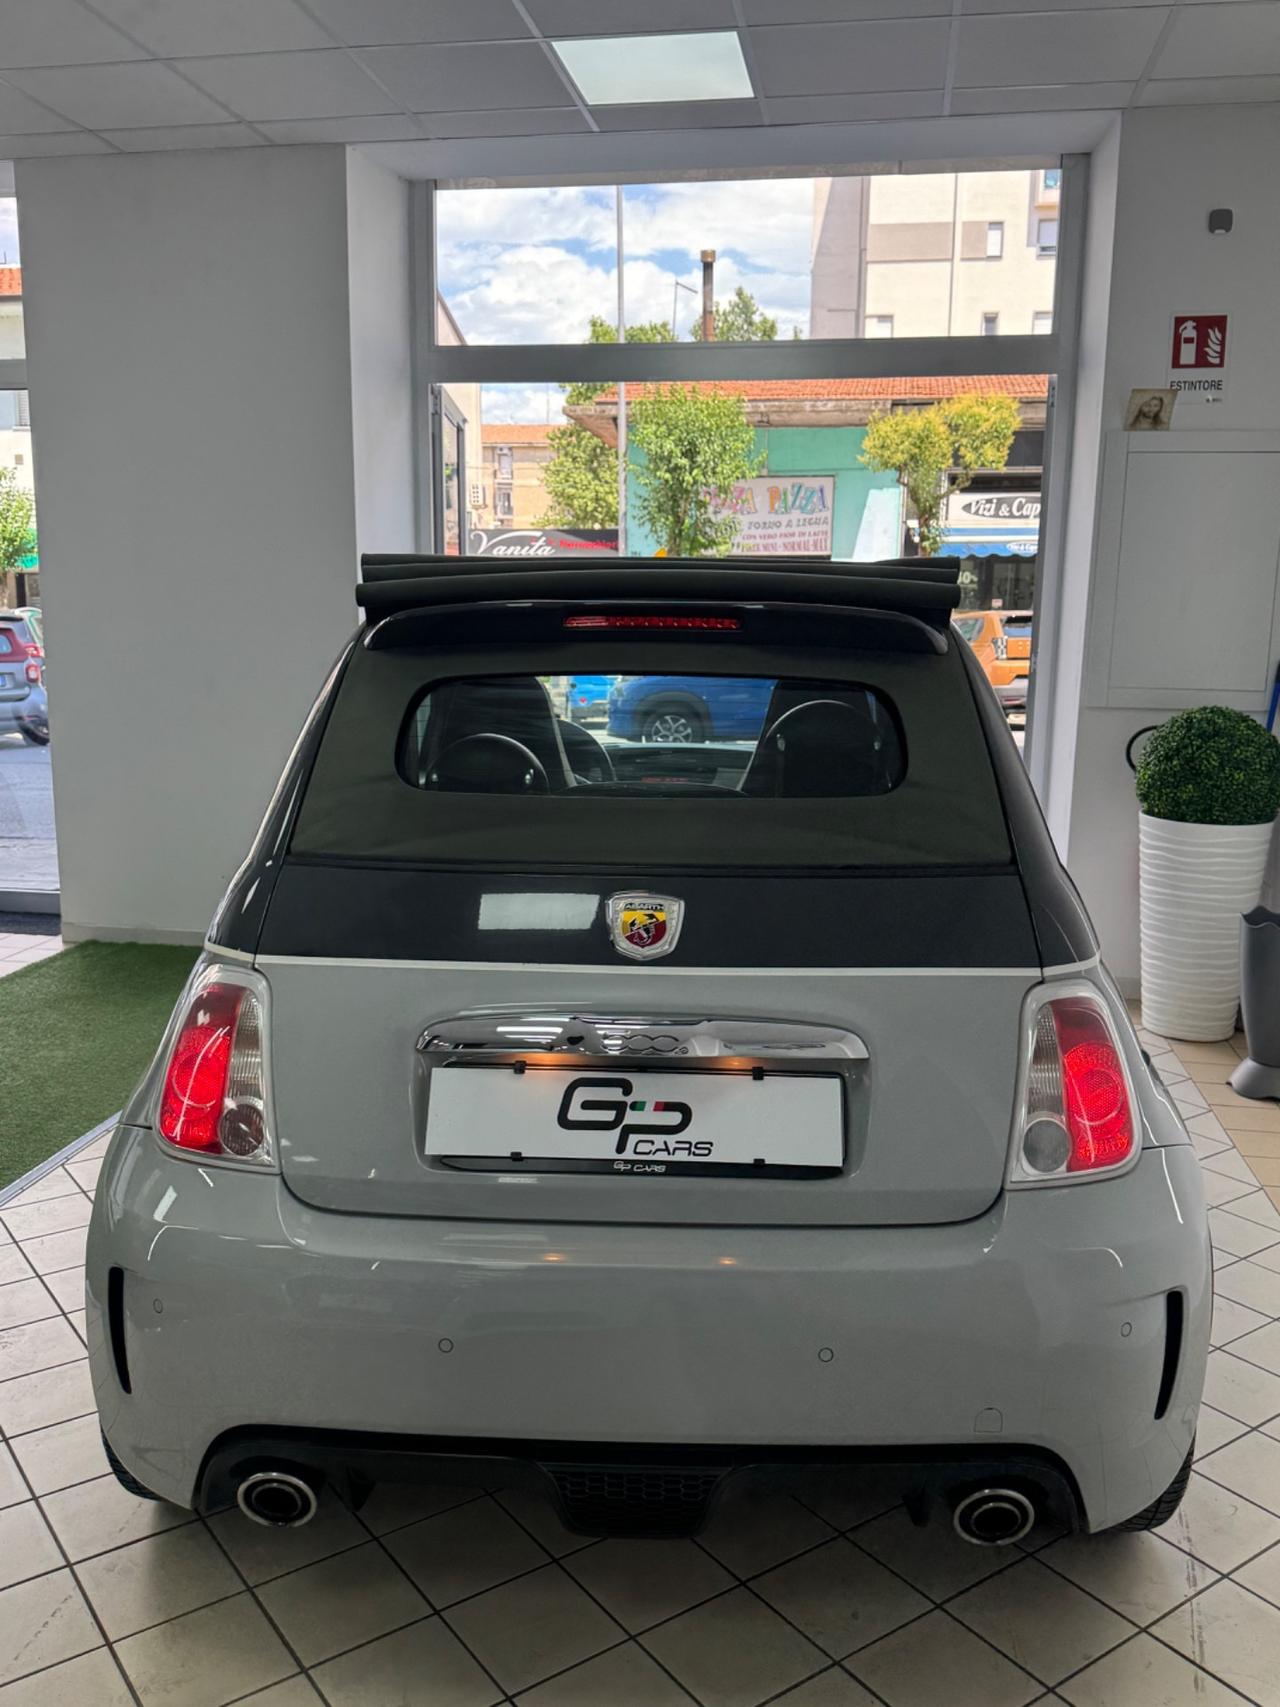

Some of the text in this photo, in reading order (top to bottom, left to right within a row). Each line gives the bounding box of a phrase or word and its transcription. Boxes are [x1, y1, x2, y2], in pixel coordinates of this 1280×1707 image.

[1169, 380, 1223, 391] ESTINTORE
[767, 482, 830, 515] PAZZA
[970, 498, 997, 516] Vizi
[633, 1139, 714, 1157] CARS
[633, 1164, 667, 1173] CARS
